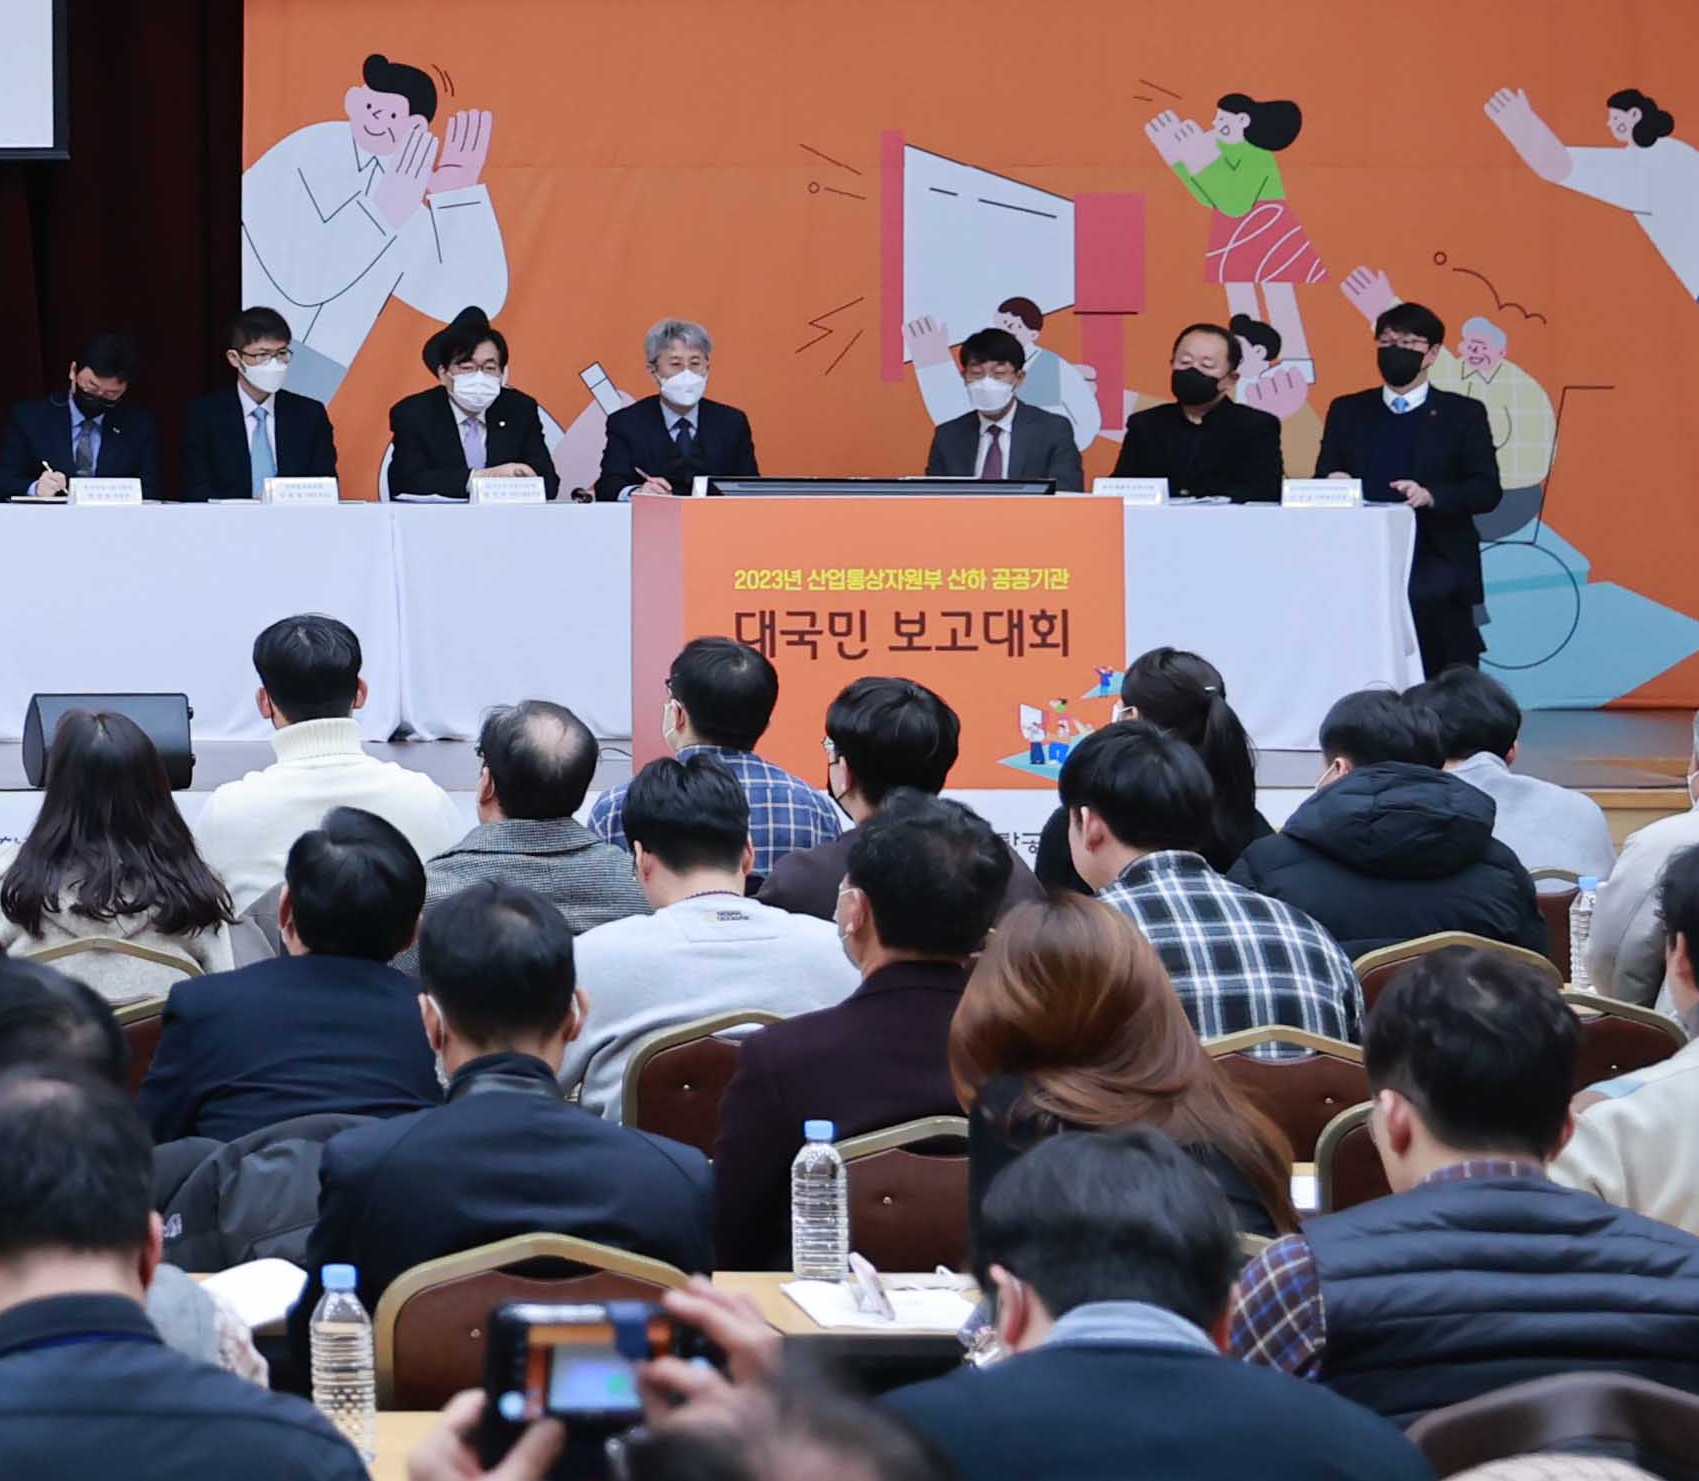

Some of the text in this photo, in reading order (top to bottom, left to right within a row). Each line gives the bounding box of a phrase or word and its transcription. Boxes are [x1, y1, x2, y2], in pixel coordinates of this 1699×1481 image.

[734, 568, 1070, 591] 2023년 산업통상자원부 산하 공공기관
[734, 609, 1070, 660] 대국민 보고대회
